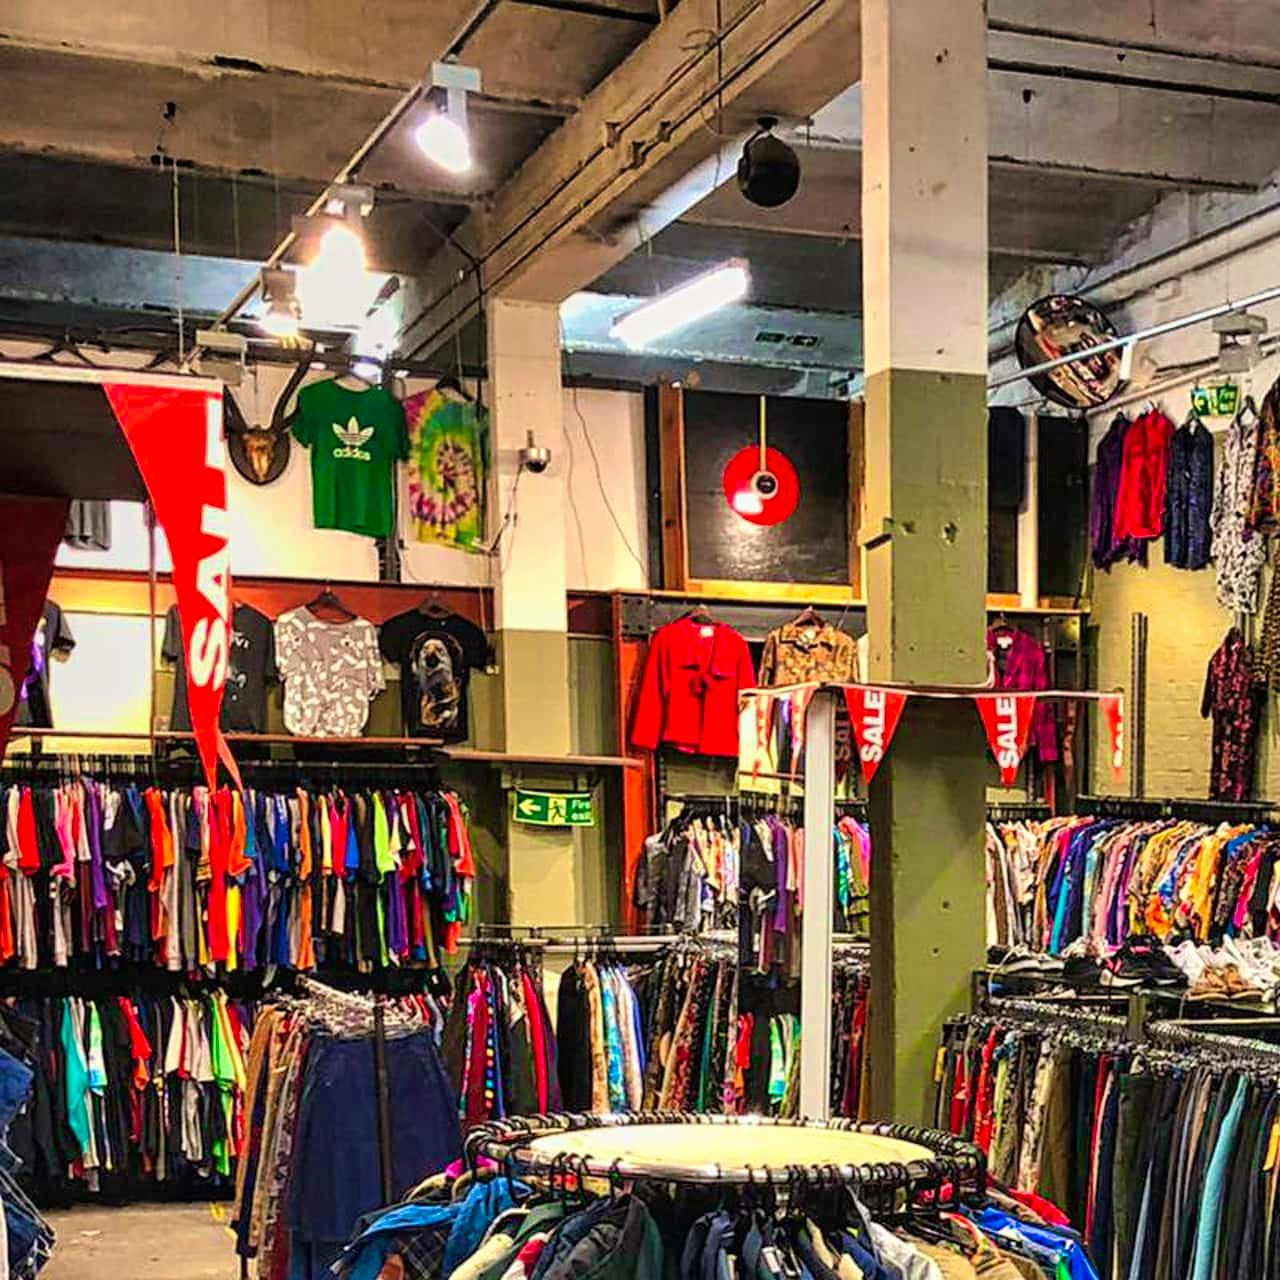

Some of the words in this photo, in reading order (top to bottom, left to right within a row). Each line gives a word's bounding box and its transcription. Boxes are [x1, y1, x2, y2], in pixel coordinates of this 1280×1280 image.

[332, 445, 371, 461] adidas
[861, 689, 886, 764] SALE
[995, 696, 1020, 769] SALE
